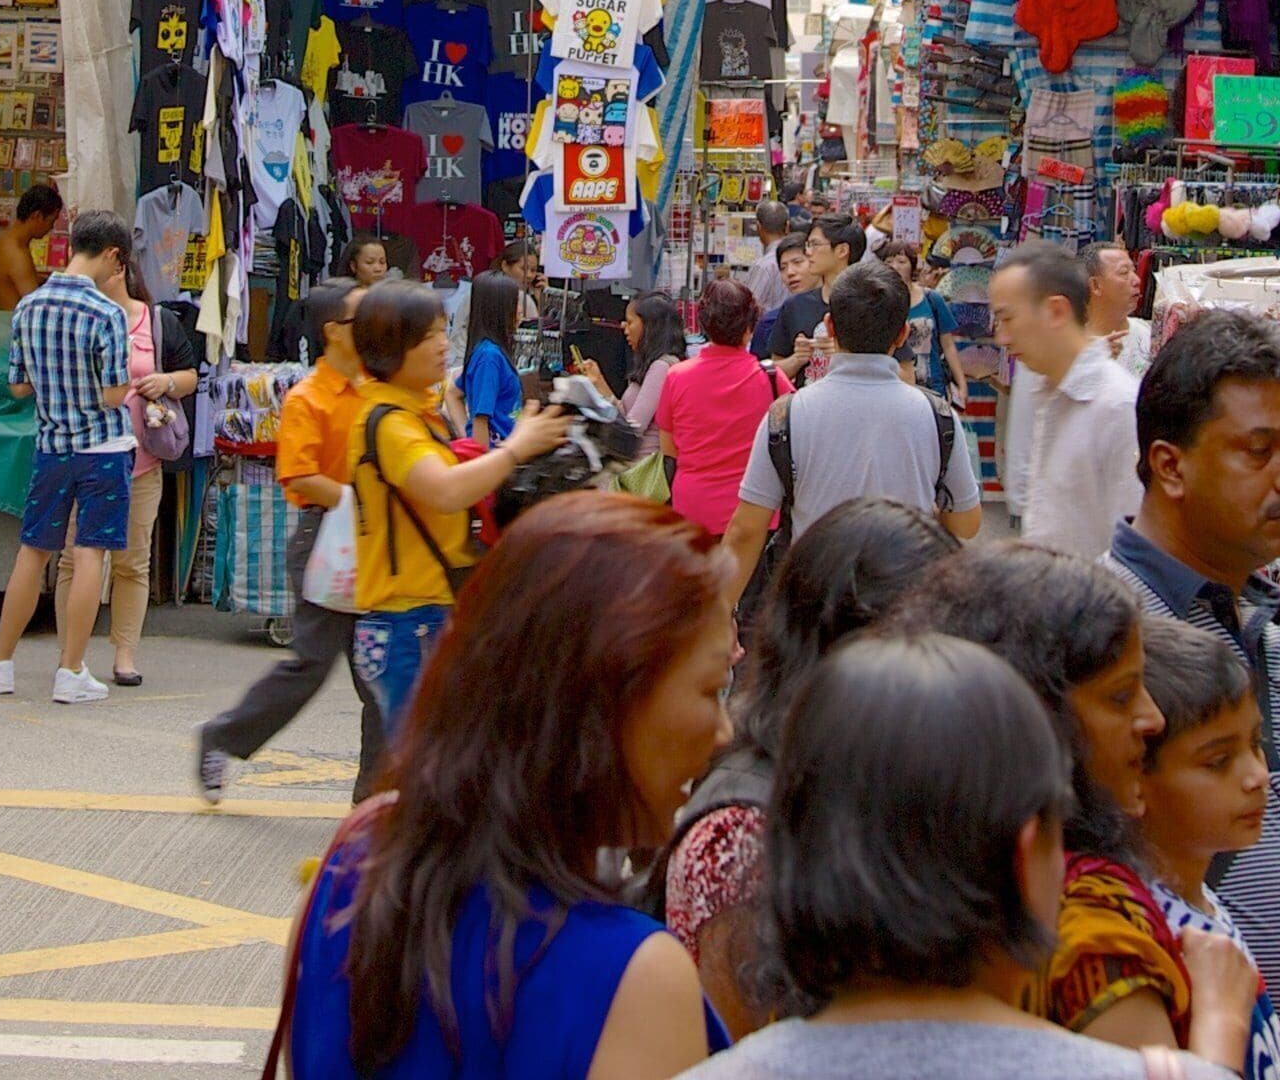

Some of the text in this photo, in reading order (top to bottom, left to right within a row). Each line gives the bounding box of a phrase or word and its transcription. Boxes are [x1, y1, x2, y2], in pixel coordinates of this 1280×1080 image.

[429, 39, 442, 62] I
[568, 47, 618, 65] PUPPET
[422, 61, 465, 87] HK
[428, 134, 439, 156] I
[425, 157, 465, 178] HK
[570, 178, 618, 201] AAPE
